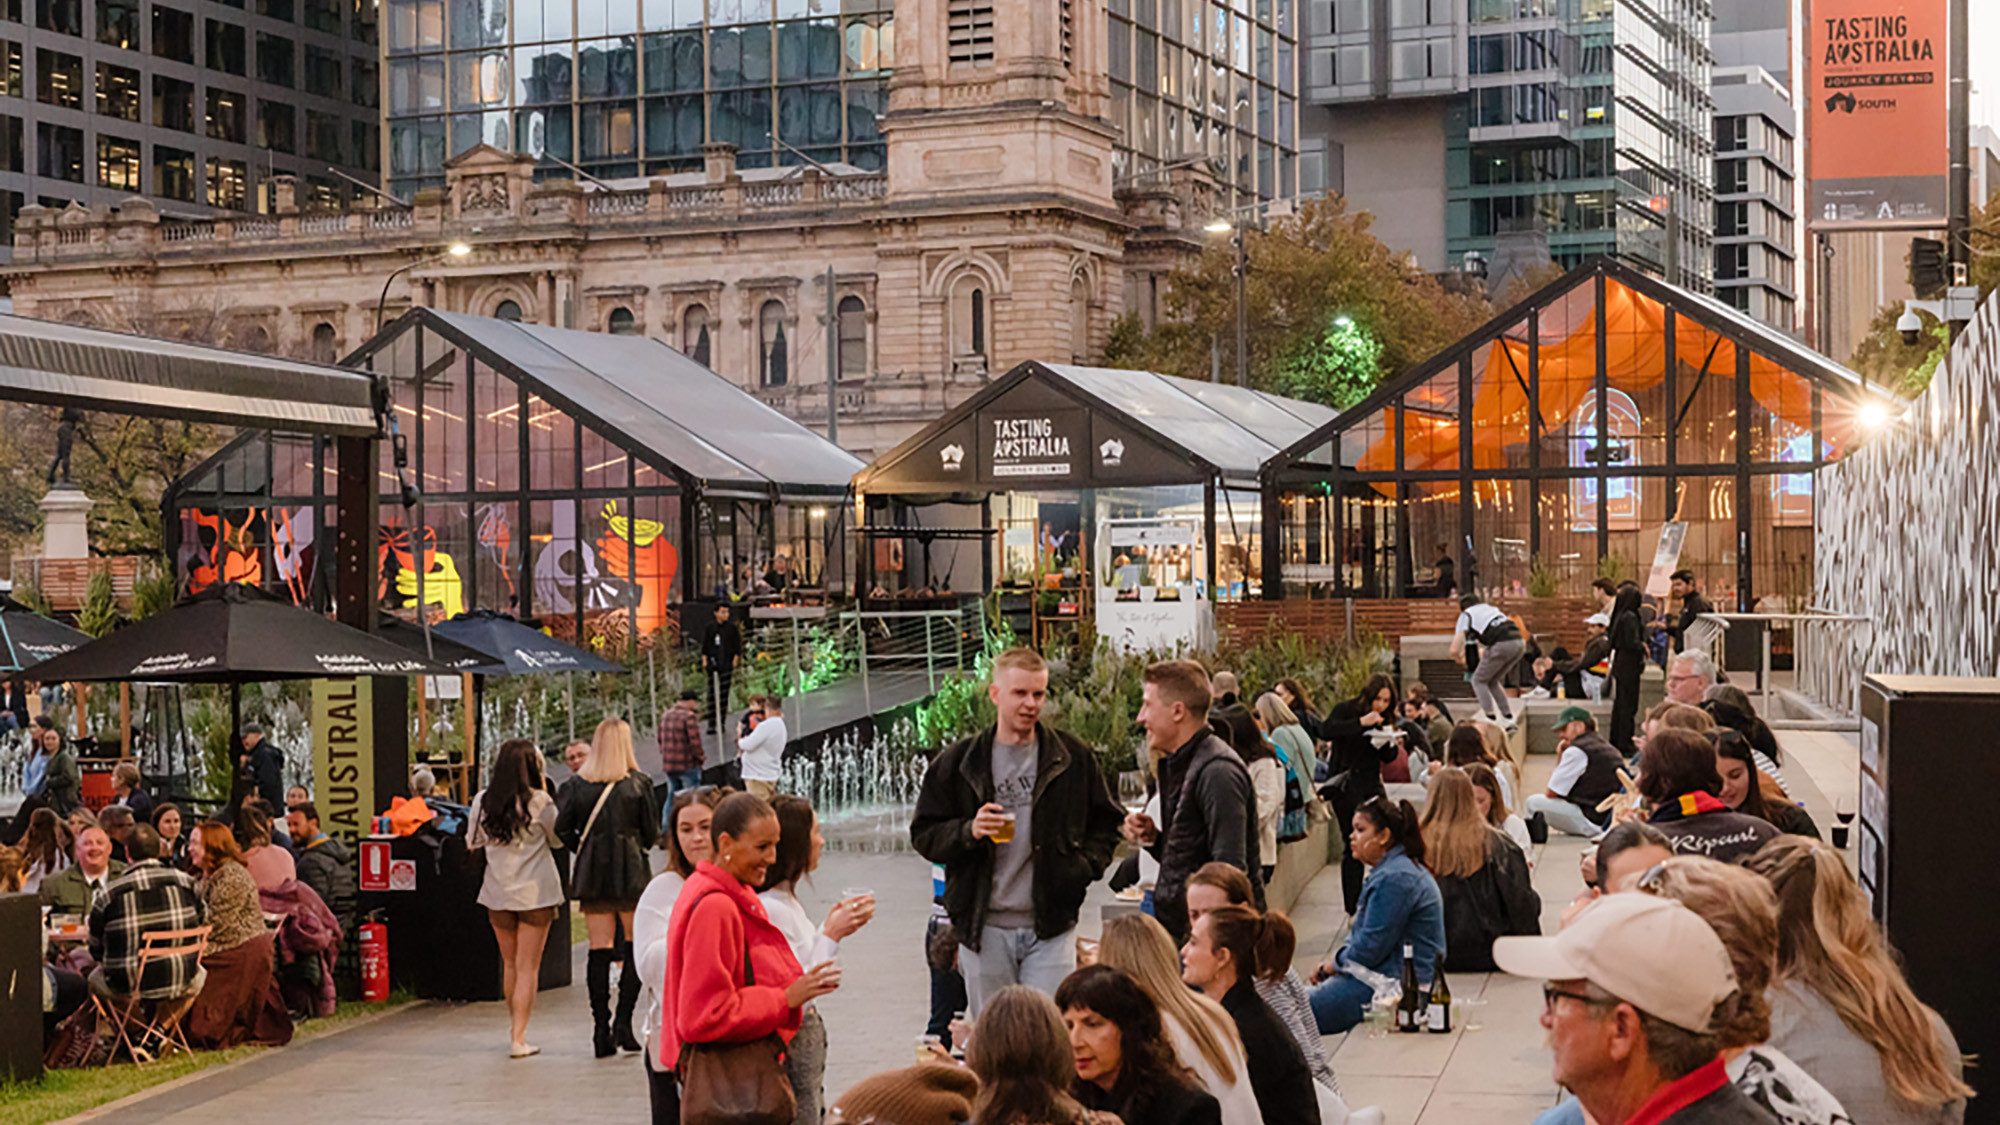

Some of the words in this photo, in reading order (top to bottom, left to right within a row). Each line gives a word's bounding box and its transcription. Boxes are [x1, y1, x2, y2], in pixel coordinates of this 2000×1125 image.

[1825, 16, 1907, 40] TASTING
[1824, 39, 1933, 65] AUSTRALIA
[1827, 75, 1880, 87] JOURNEY
[1885, 73, 1931, 84] BEYOND
[1858, 99, 1896, 109] SOUTH
[994, 419, 1052, 438] TASTING
[993, 437, 1071, 458] AUSTRALIA
